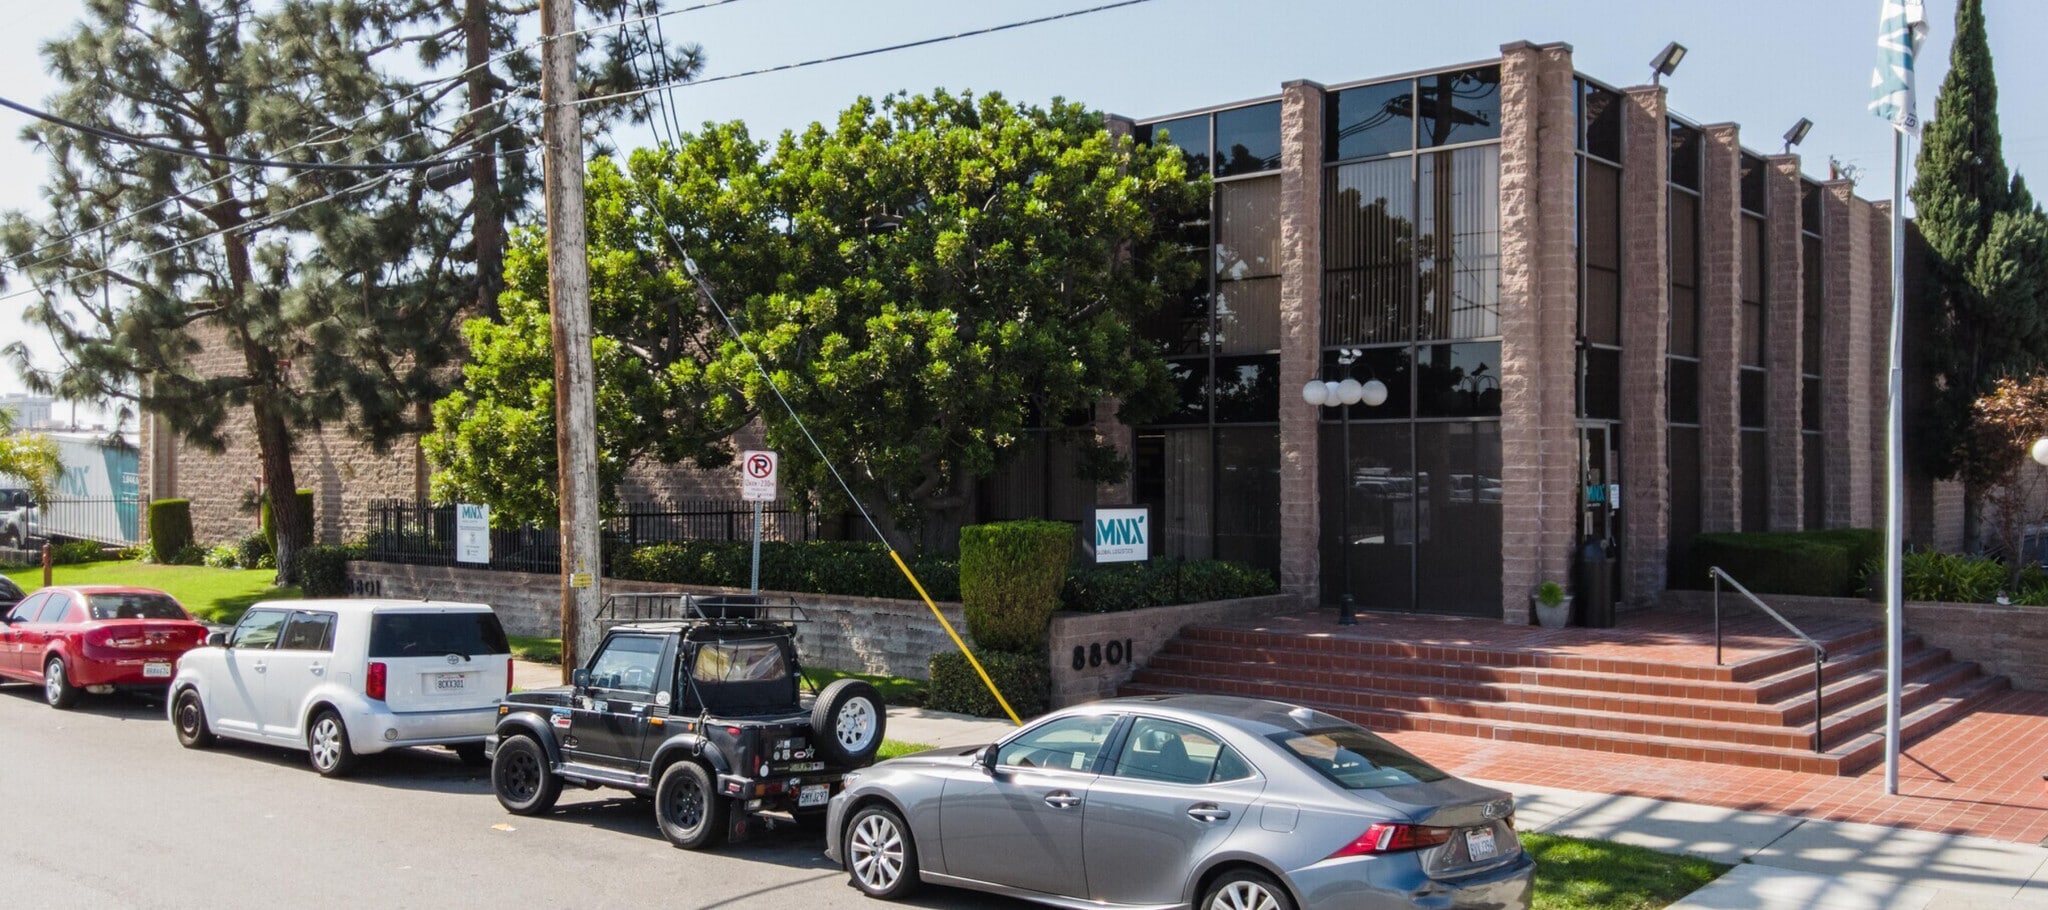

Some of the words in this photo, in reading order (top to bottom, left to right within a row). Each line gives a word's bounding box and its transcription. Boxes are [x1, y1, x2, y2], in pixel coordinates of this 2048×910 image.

[462, 506, 483, 519] MNX
[1096, 516, 1144, 546] MNX
[1072, 639, 1132, 671] 8801
